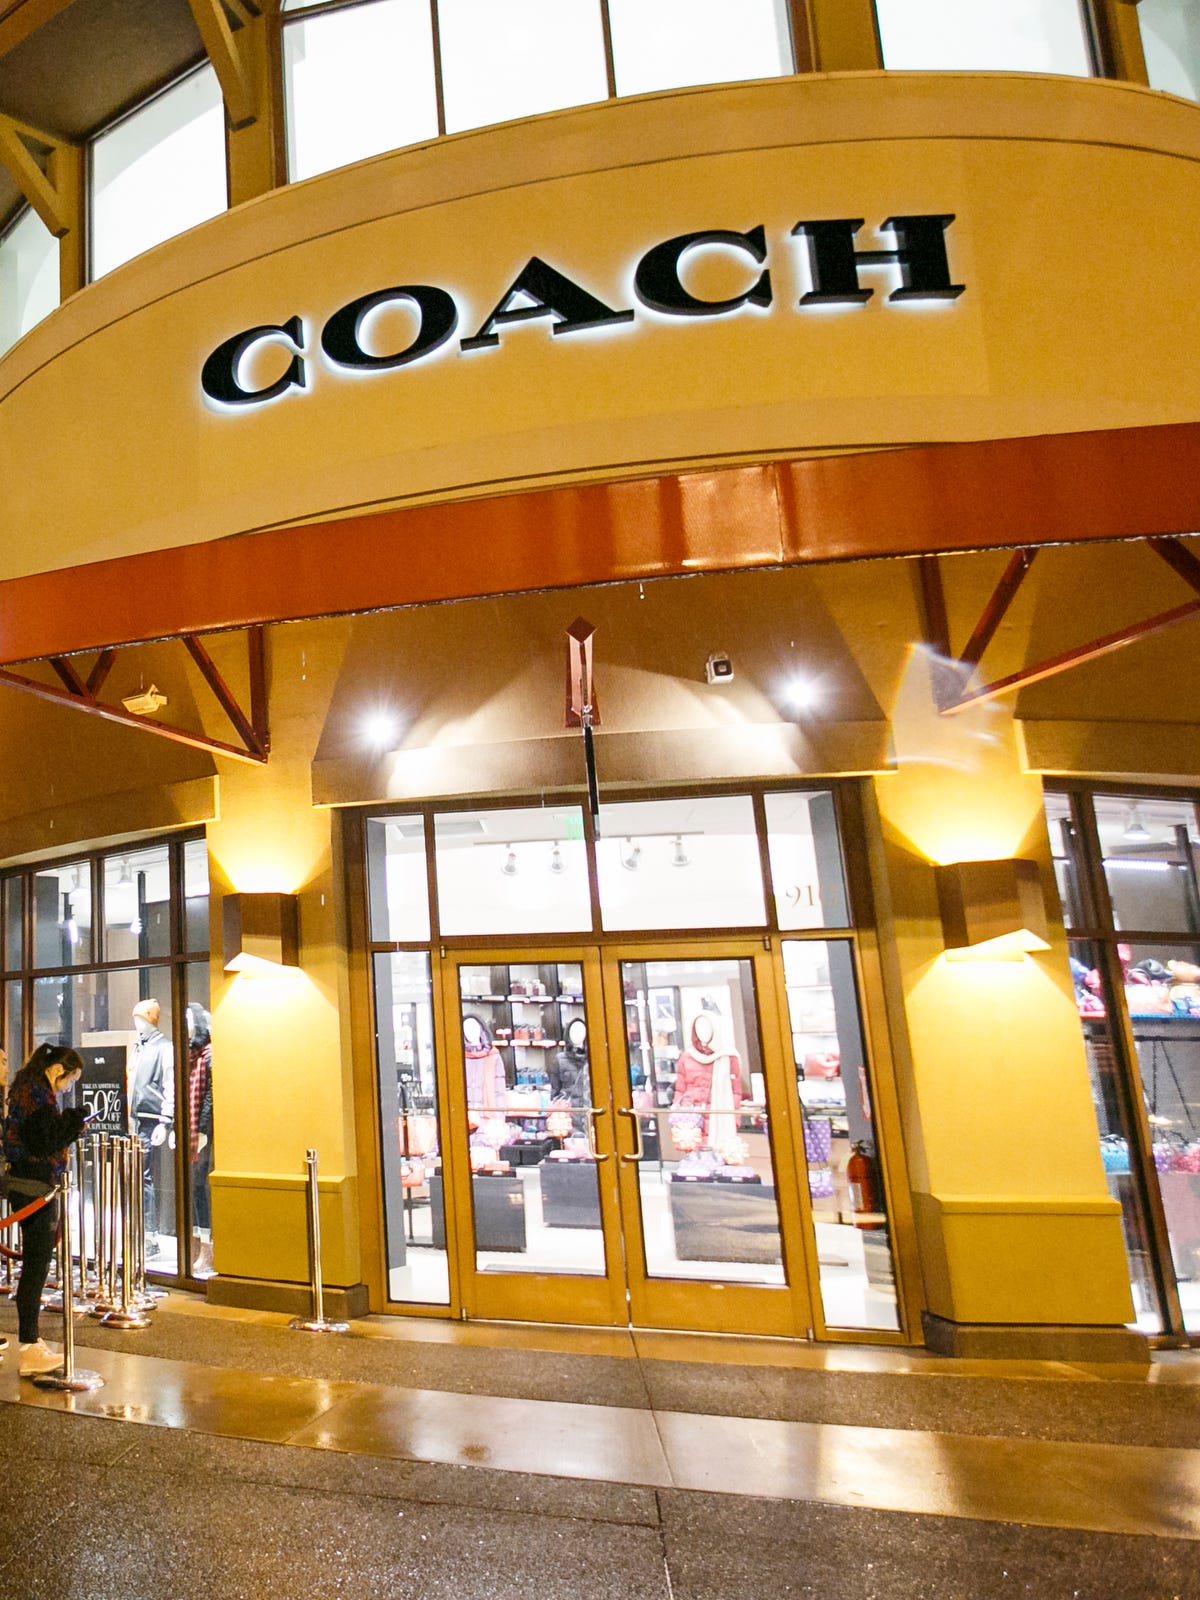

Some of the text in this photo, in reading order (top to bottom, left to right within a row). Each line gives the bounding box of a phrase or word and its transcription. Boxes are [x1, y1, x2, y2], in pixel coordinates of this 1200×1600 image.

[200, 213, 967, 407] COACH
[82, 1090, 121, 1122] 50%
[108, 1112, 121, 1122] OFF
